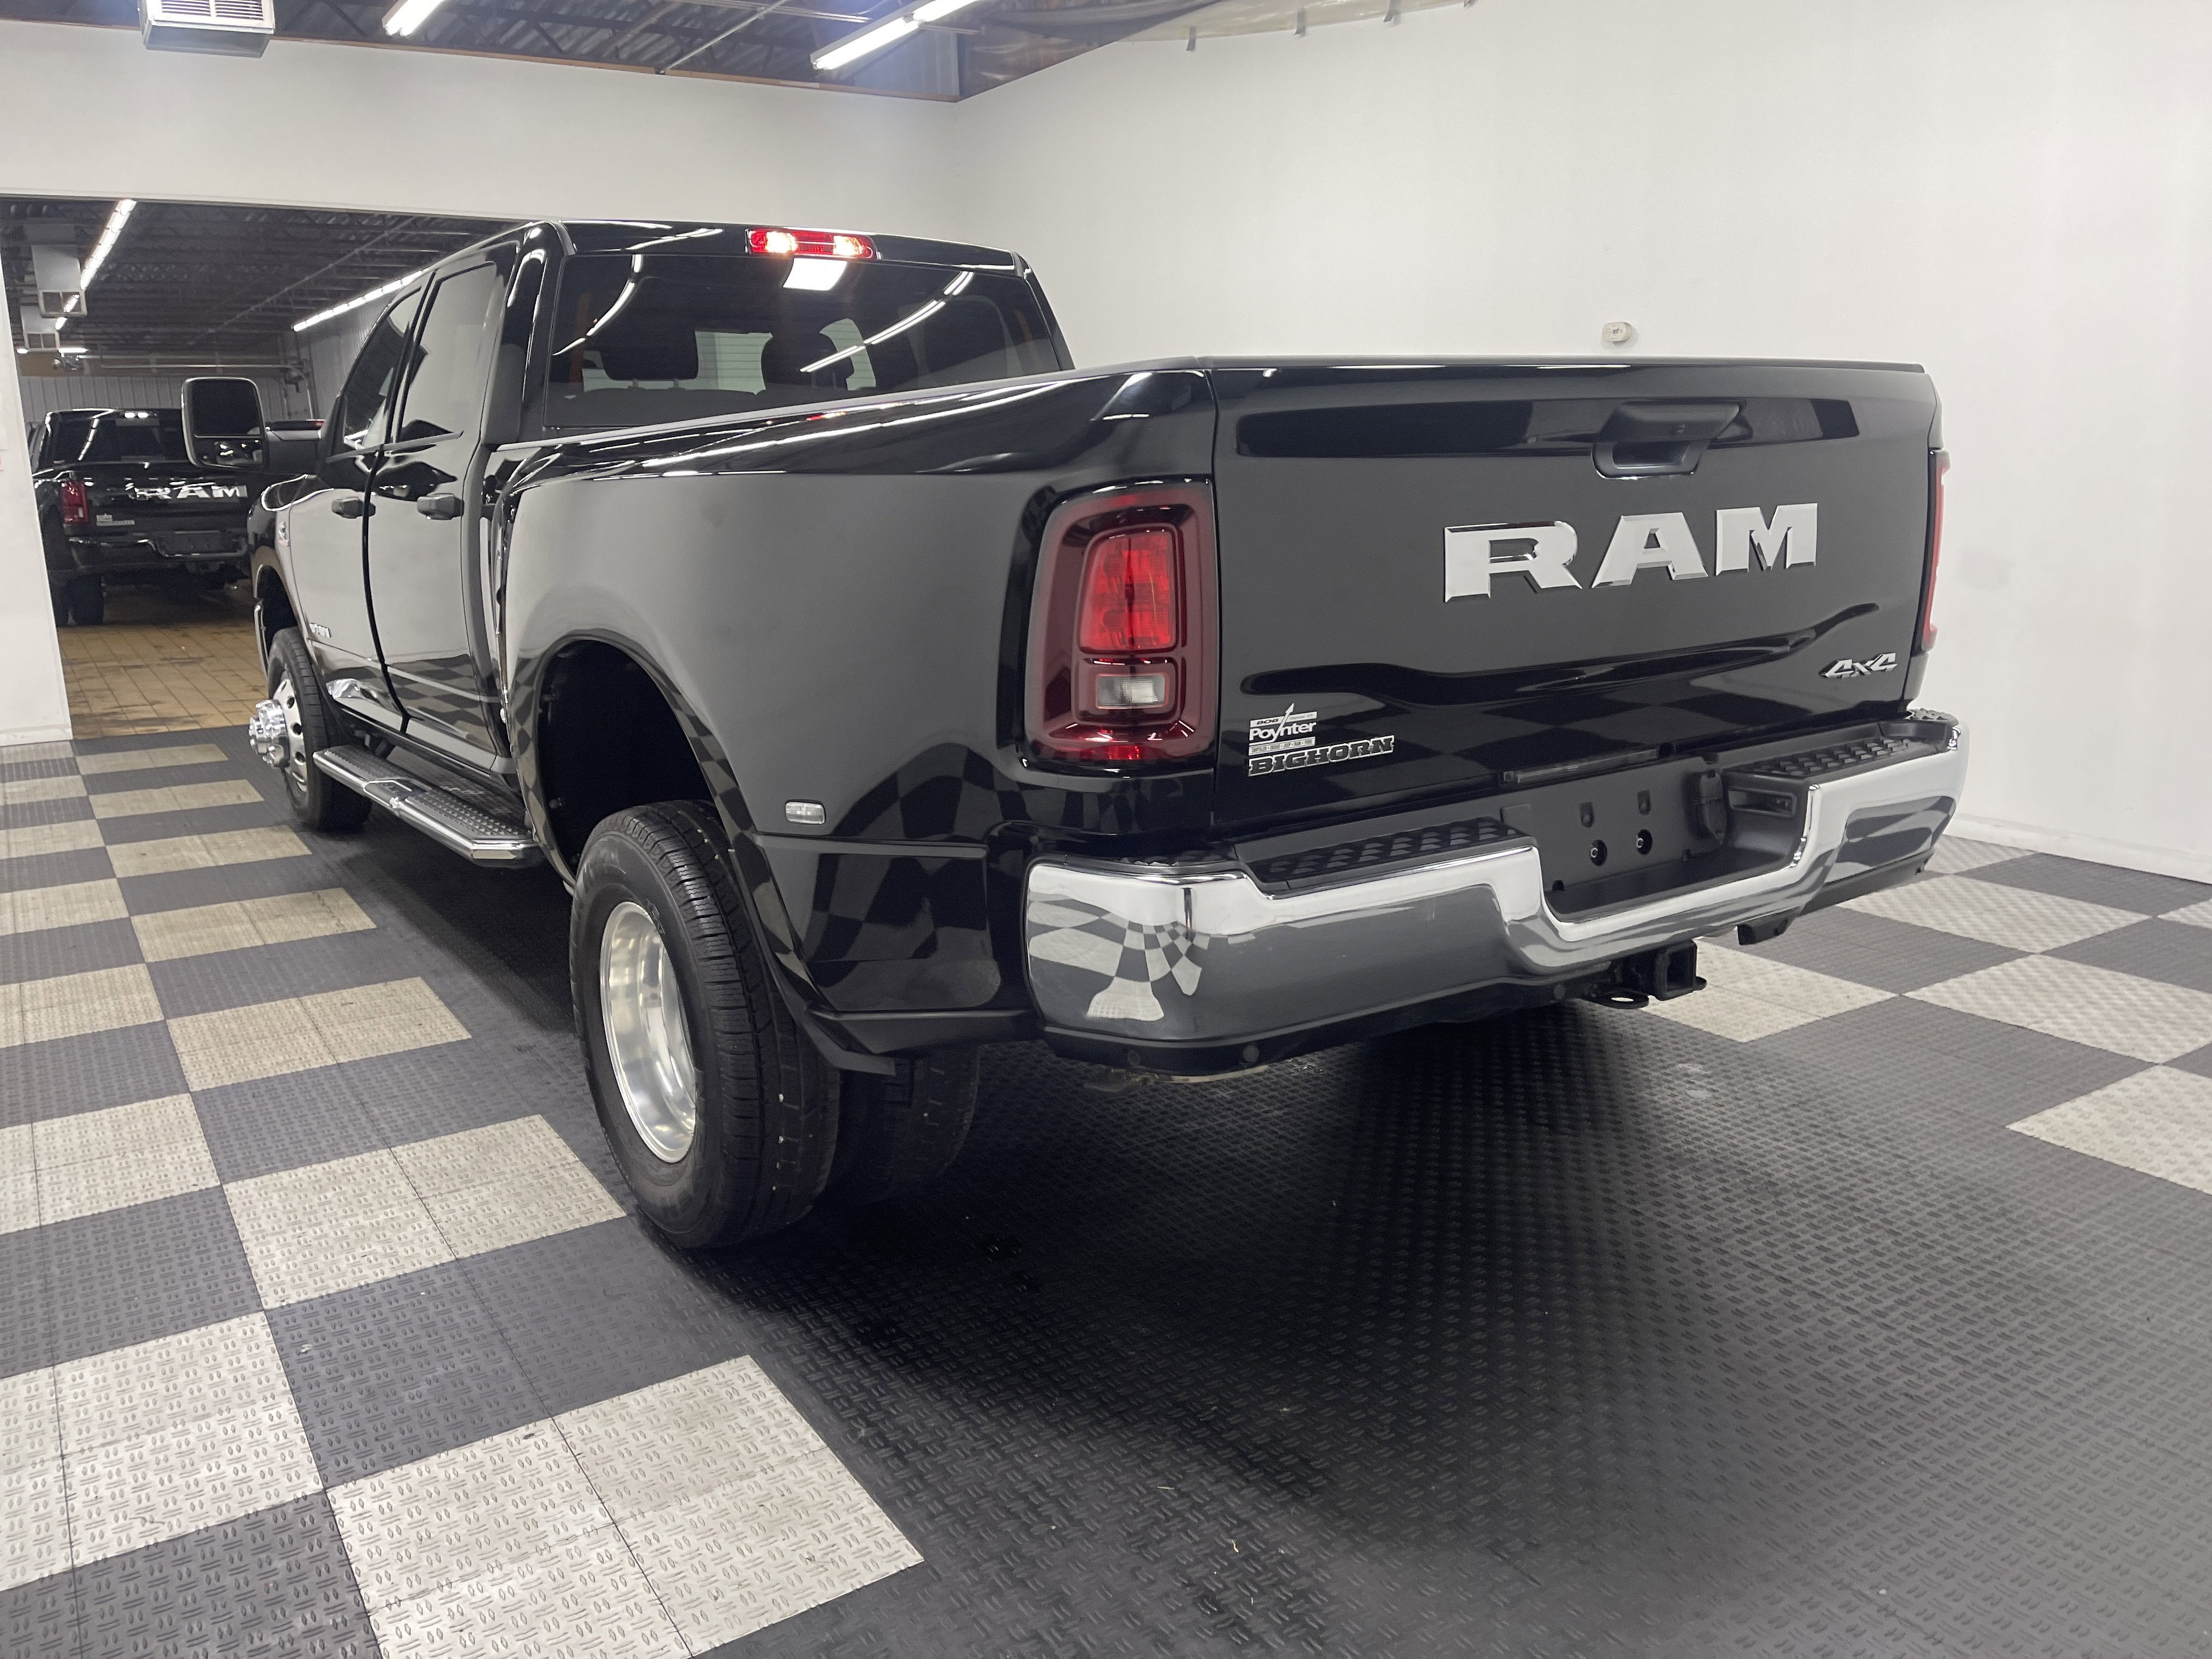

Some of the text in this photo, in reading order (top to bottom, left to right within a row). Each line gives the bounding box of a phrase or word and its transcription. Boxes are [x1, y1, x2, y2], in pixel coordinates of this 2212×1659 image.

[135, 486, 247, 500] RAM
[1444, 503, 1818, 602] RAM
[1821, 652, 1898, 678] 4x4
[1249, 722, 1317, 742] Poynter
[1248, 735, 1395, 777] BIGHORN
